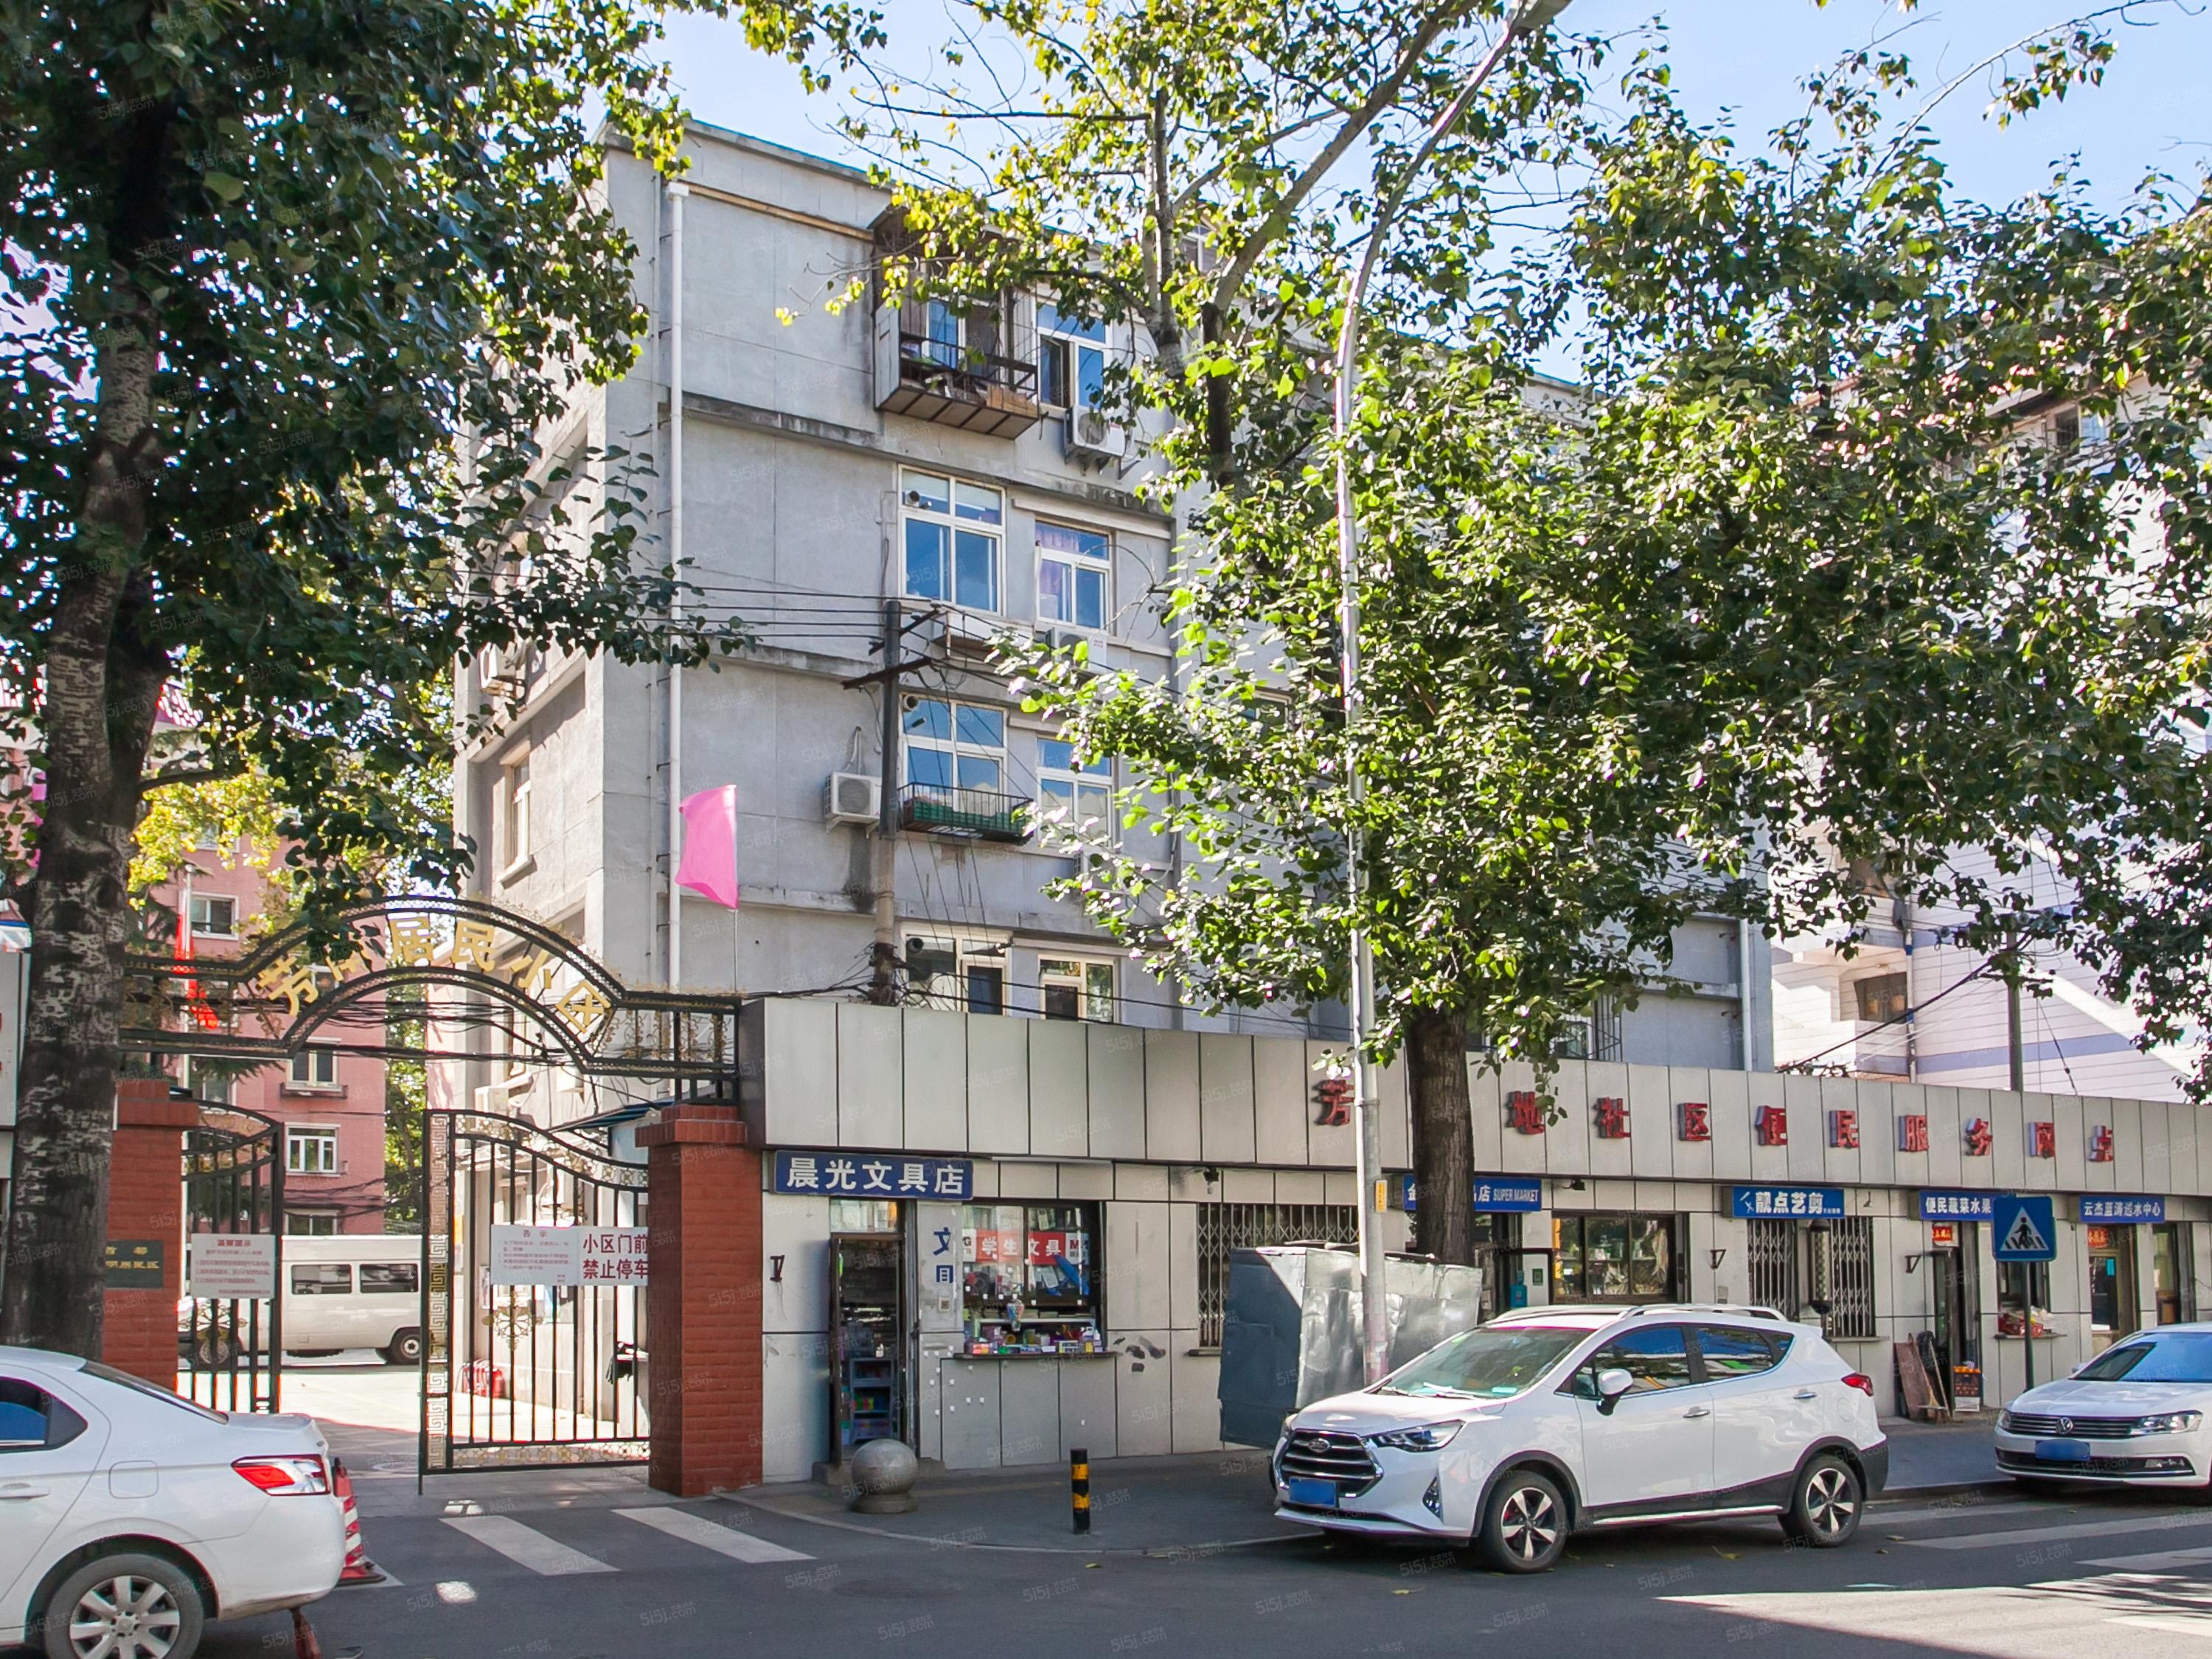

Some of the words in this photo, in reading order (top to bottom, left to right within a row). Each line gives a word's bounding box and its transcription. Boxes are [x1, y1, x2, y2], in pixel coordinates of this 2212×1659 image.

[787, 1157, 964, 1194] 晨光文具店
[1493, 1189, 1513, 1202] SUPER
[1514, 1189, 1539, 1202] MARKET
[1925, 1197, 1991, 1214] 便民蔬菜水果
[582, 1234, 648, 1253] 小区门前
[582, 1259, 648, 1279] 禁止停车
